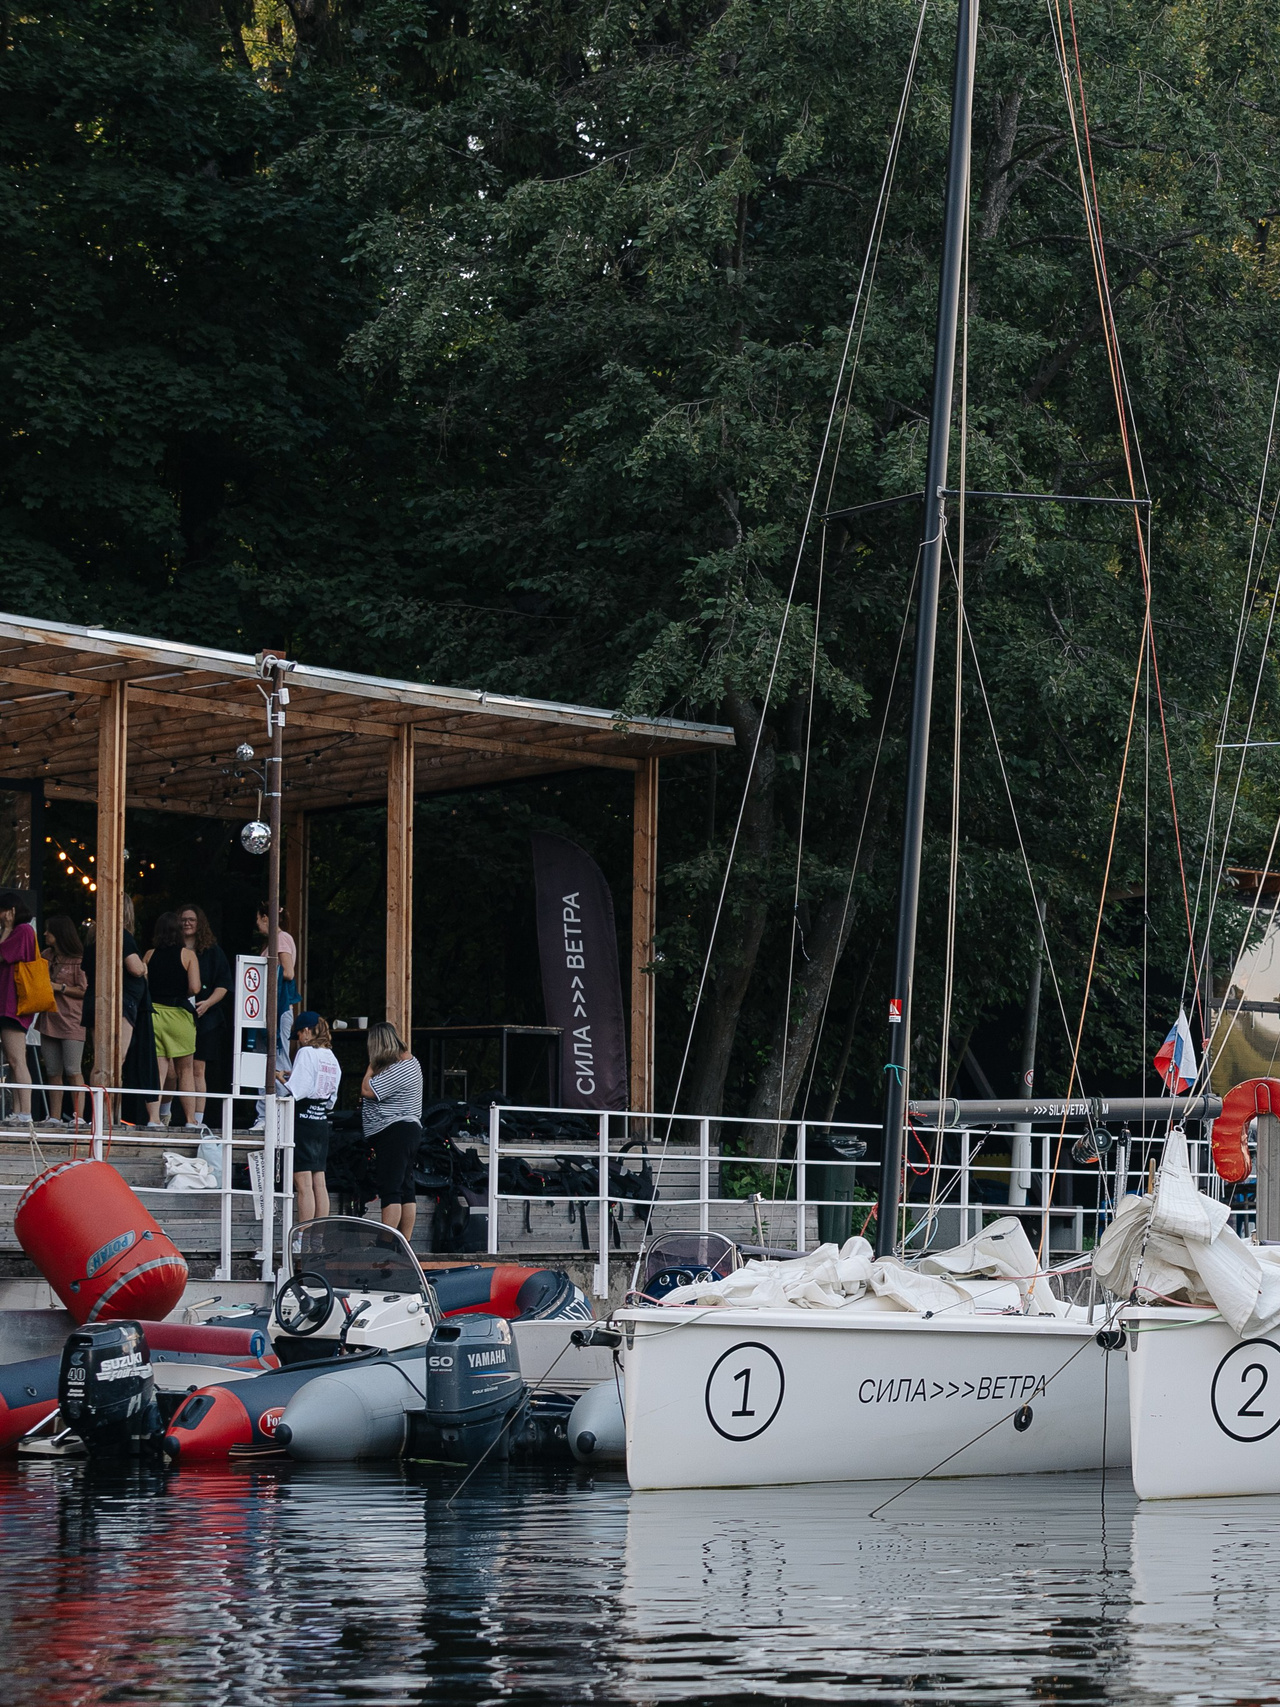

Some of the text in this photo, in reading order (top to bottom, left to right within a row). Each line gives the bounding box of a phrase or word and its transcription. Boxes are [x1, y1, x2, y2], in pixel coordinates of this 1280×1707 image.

[562, 891, 585, 969] ВЕТРА
[572, 1025, 596, 1095] СИЛА
[1048, 1103, 1109, 1116] SILAVETRA.M
[100, 1351, 143, 1373] SUZUKI
[429, 1356, 454, 1367] 60
[467, 1349, 507, 1368] YAMAHA
[67, 1367, 86, 1381] 40
[731, 1368, 755, 1417] 1
[1237, 1363, 1268, 1417] 2
